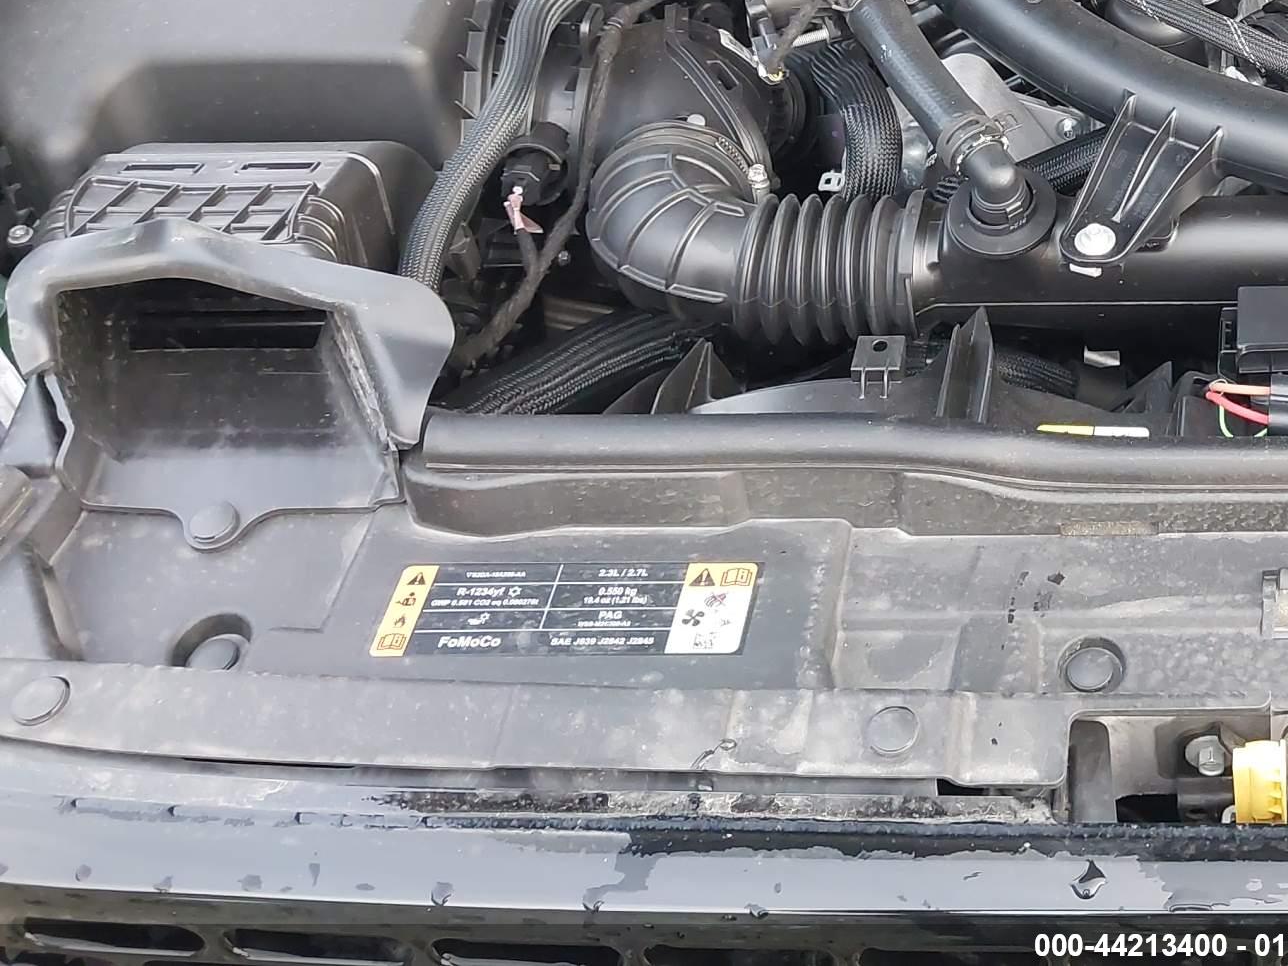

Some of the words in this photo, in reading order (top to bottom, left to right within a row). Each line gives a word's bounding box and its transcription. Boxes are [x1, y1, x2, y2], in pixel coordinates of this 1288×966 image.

[456, 586, 505, 598] R-1234yf
[597, 610, 623, 620] PAG
[437, 635, 502, 648] FoMoCo
